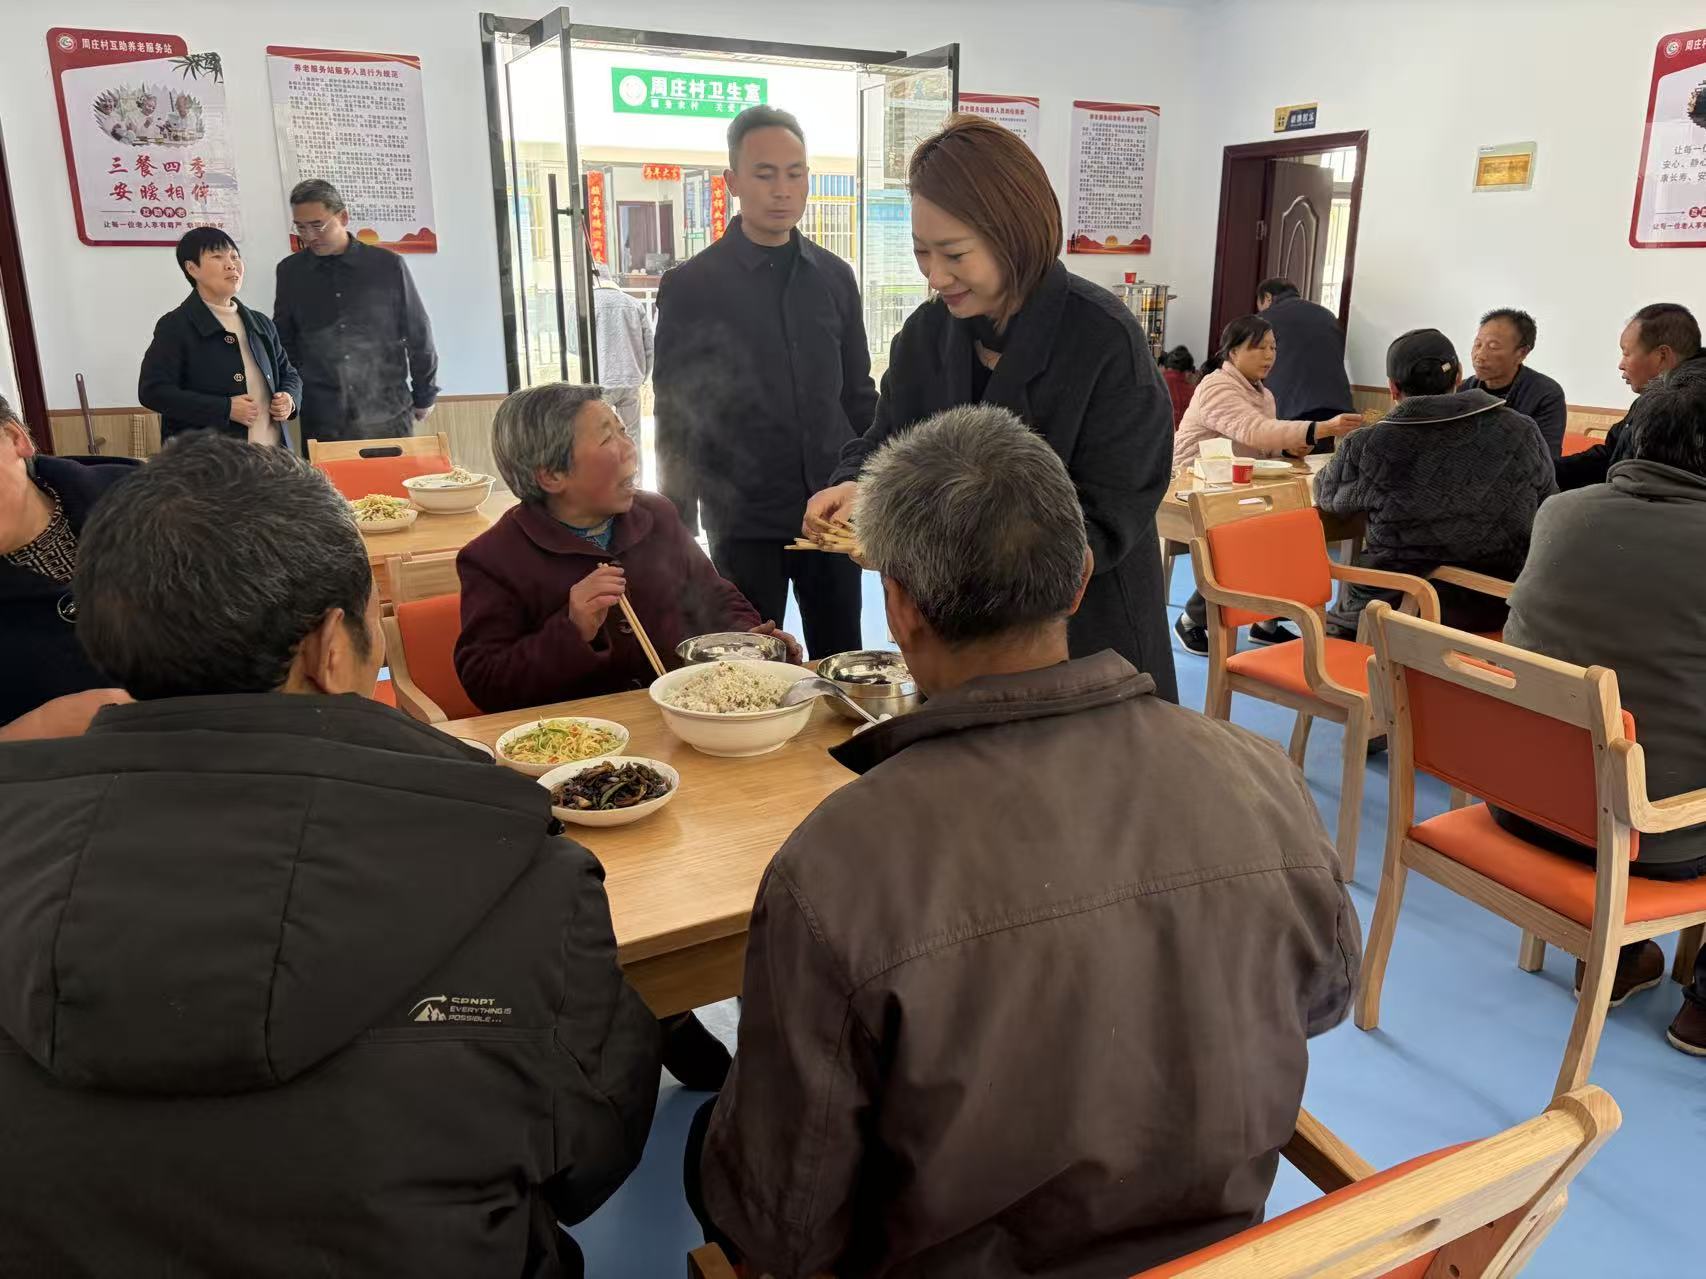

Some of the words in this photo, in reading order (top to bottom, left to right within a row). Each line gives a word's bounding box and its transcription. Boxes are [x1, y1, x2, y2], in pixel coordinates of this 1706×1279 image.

[82, 38, 172, 54] 周庄村互助养老服务站
[293, 63, 399, 78] 养老服务站服务人员行为规范
[651, 76, 760, 102] 周庄村卫生室
[107, 154, 206, 179] 三餐四季
[110, 182, 211, 204] 安暖相伴
[140, 207, 187, 218] 互助养老
[449, 1005, 503, 1014] EVERYTHING
[503, 1007, 513, 1015] IS
